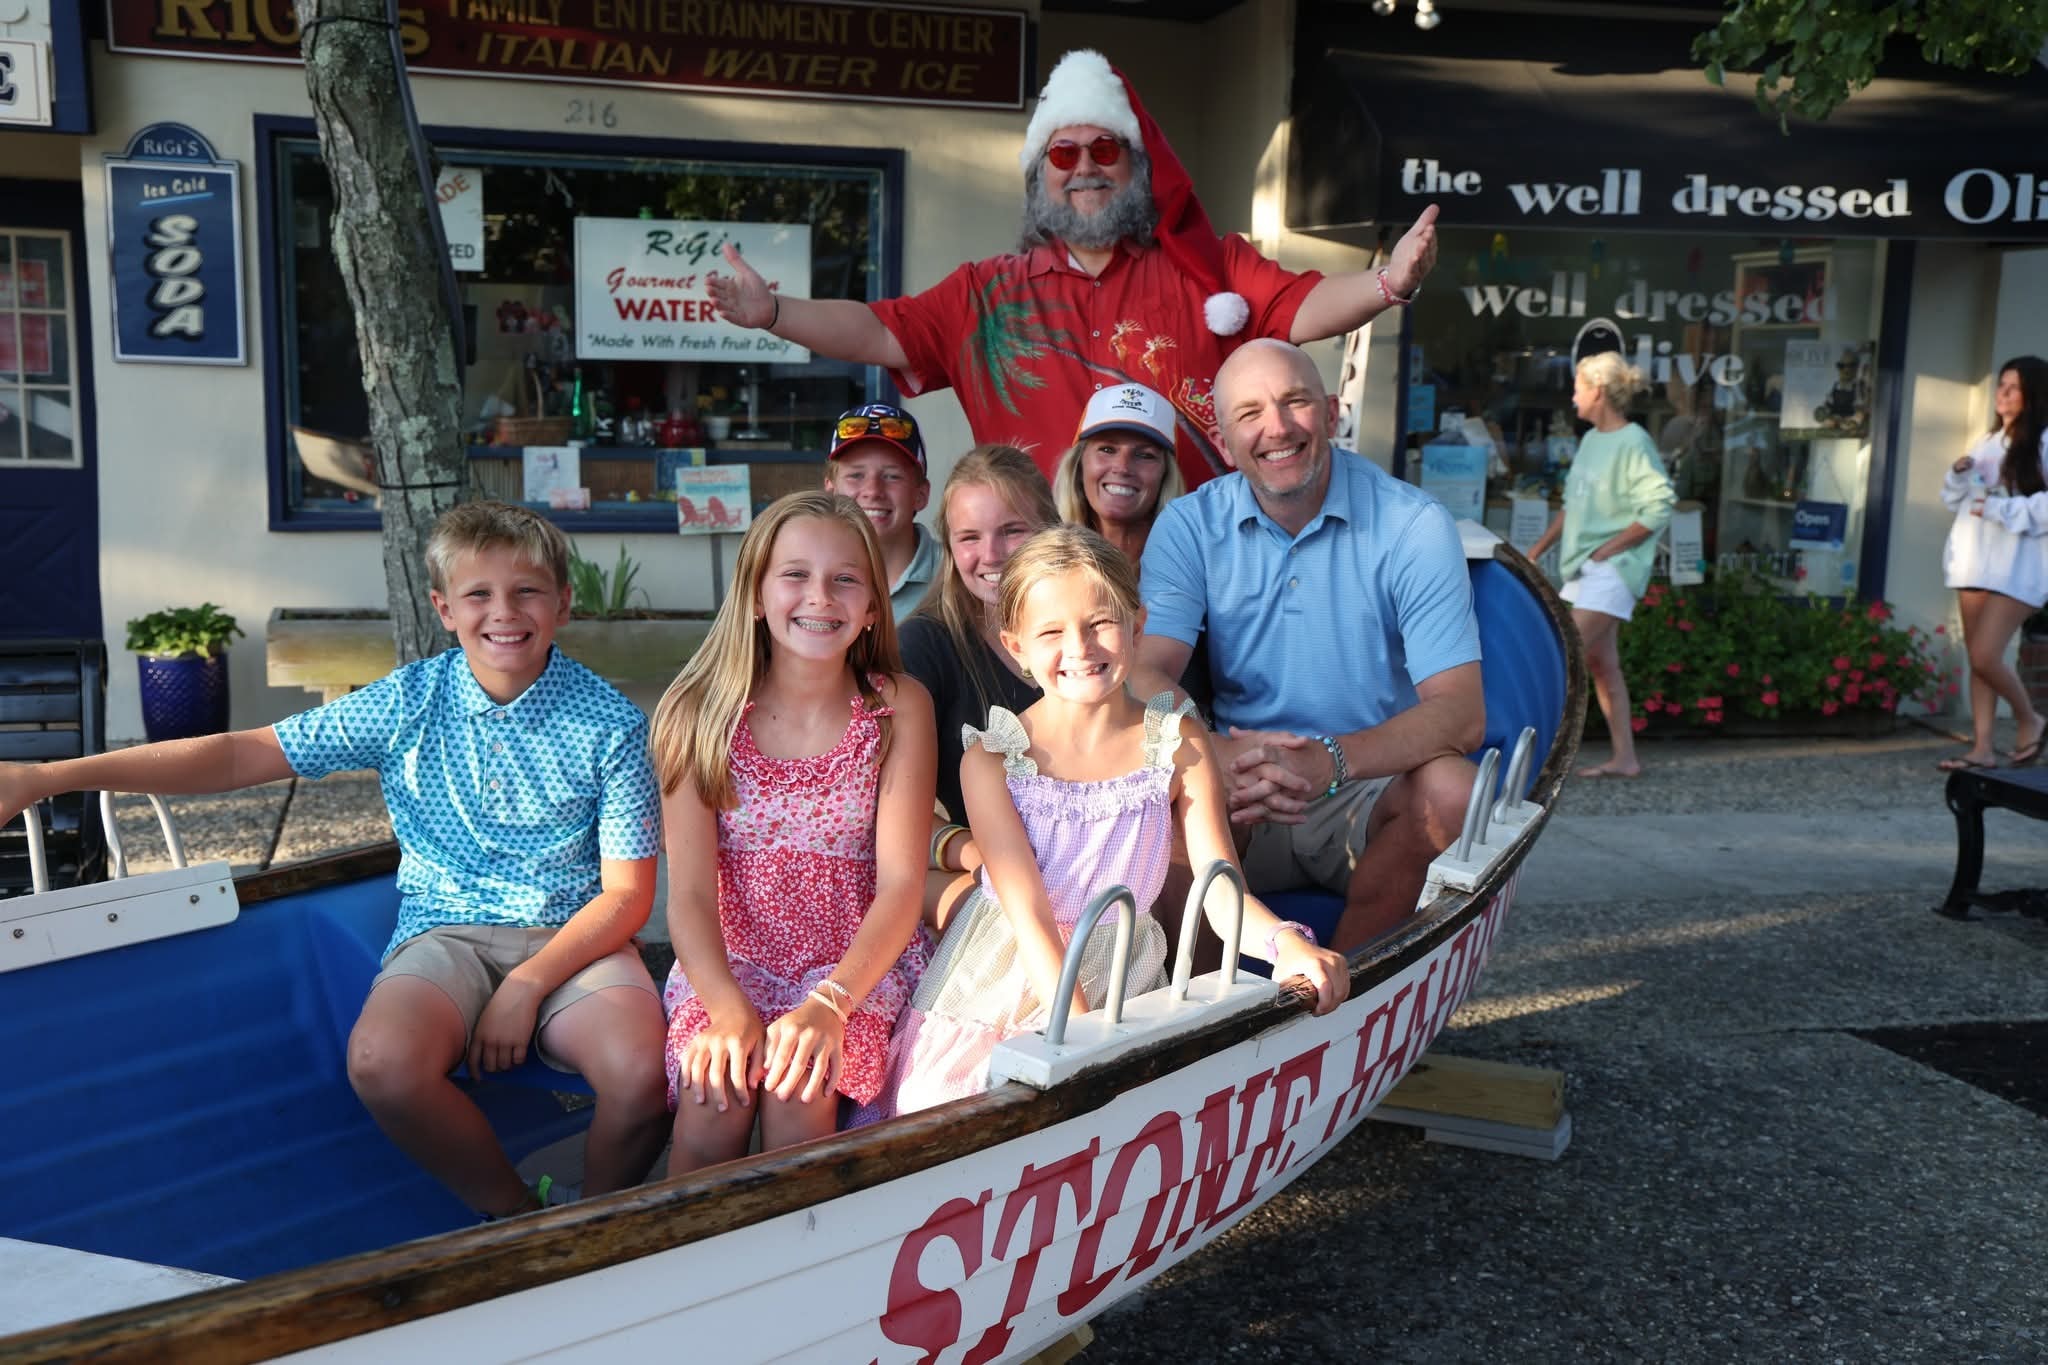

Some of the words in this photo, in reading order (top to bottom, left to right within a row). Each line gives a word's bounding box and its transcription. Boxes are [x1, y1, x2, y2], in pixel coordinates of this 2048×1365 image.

[593, 0, 855, 45] ENTERTAINMENT
[868, 8, 993, 54] CENTER
[476, 32, 672, 76] ITALIAN
[703, 48, 877, 89] WATER
[901, 60, 981, 94] ICE
[564, 99, 617, 129] 216
[143, 184, 168, 198] Ice
[172, 176, 207, 194] Cold
[1401, 158, 1482, 195] the
[1507, 169, 1642, 215] well
[1672, 174, 1912, 222] dressed
[150, 214, 204, 337] SODA
[606, 267, 696, 294] Gourmet
[1461, 271, 1587, 318] well
[1615, 279, 1838, 326] dressed
[614, 298, 717, 322] WATER
[641, 334, 675, 348] With
[680, 335, 717, 350] Fresh
[721, 335, 752, 350] Fruit
[868, 1041, 1332, 1365] STONE
